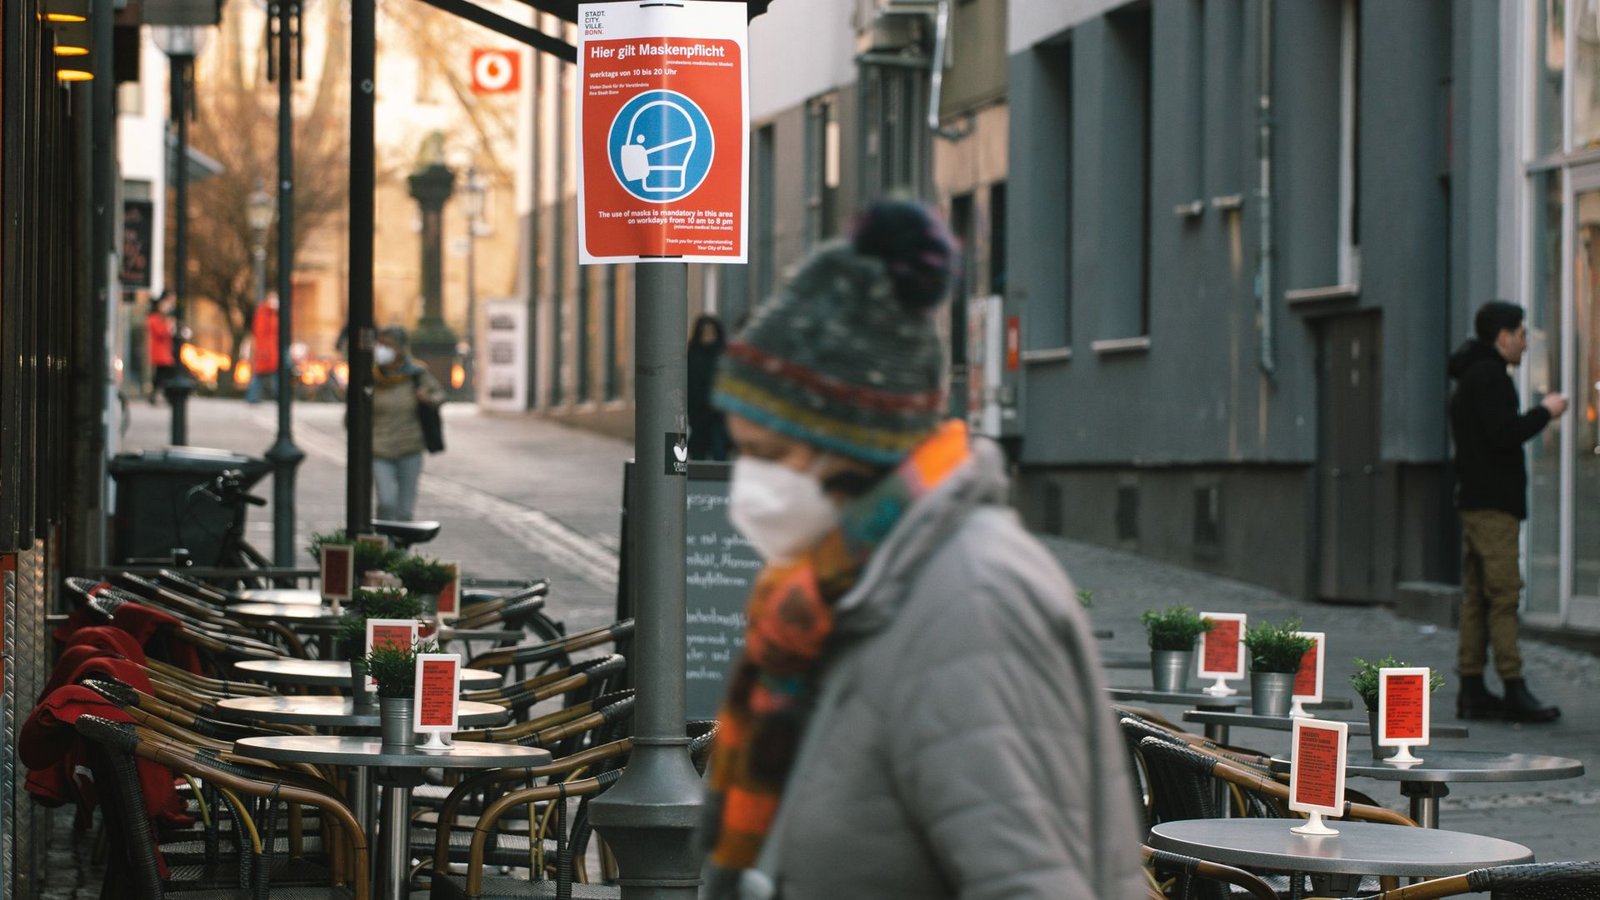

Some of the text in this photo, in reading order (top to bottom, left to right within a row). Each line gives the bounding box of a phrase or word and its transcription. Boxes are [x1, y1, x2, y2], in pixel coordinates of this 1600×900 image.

[591, 43, 725, 60] Hier gilt Maskenpflicht
[660, 210, 696, 218] mandatory
[636, 217, 668, 225] workdays
